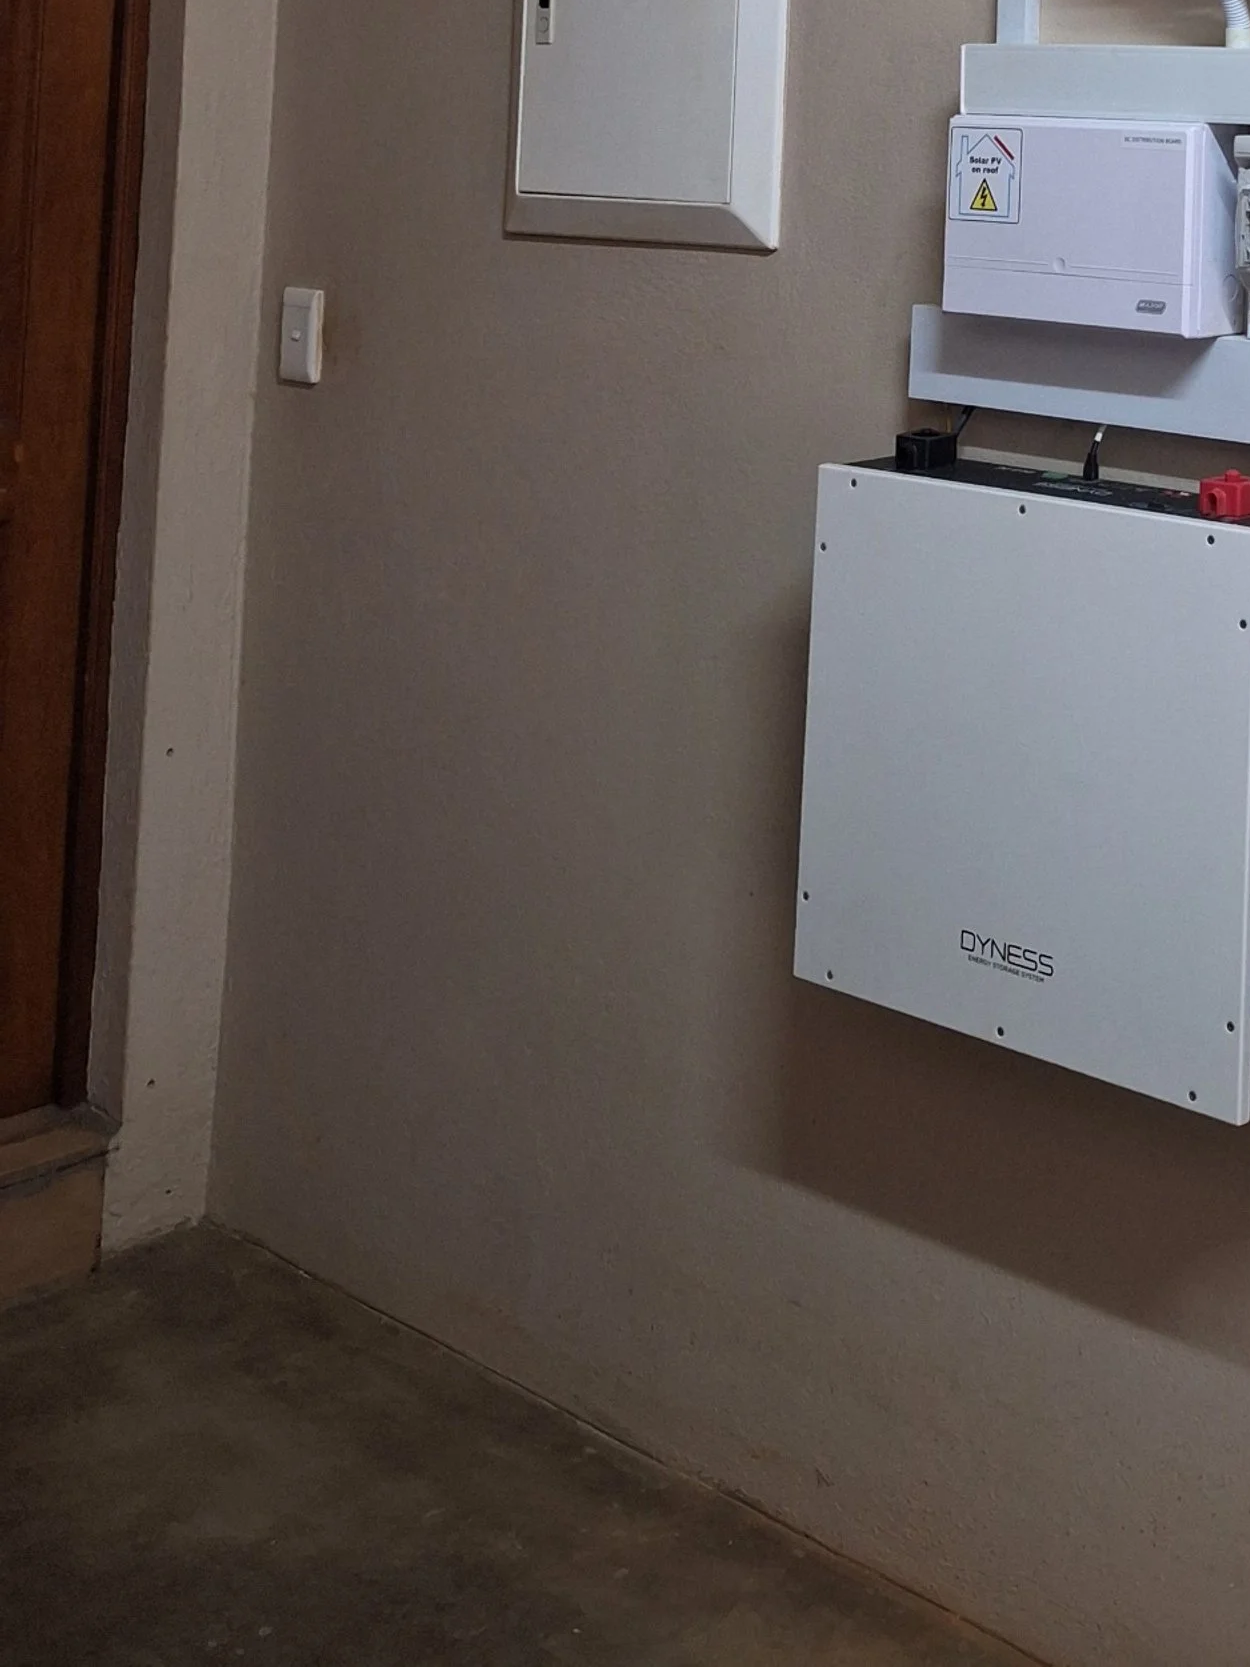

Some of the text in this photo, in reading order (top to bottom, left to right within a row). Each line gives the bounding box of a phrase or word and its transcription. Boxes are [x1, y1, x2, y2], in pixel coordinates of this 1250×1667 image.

[969, 156, 1002, 165] Solar PV
[982, 166, 999, 174] roof
[961, 929, 1054, 977] DYNESS
[967, 954, 991, 966] ENERGY
